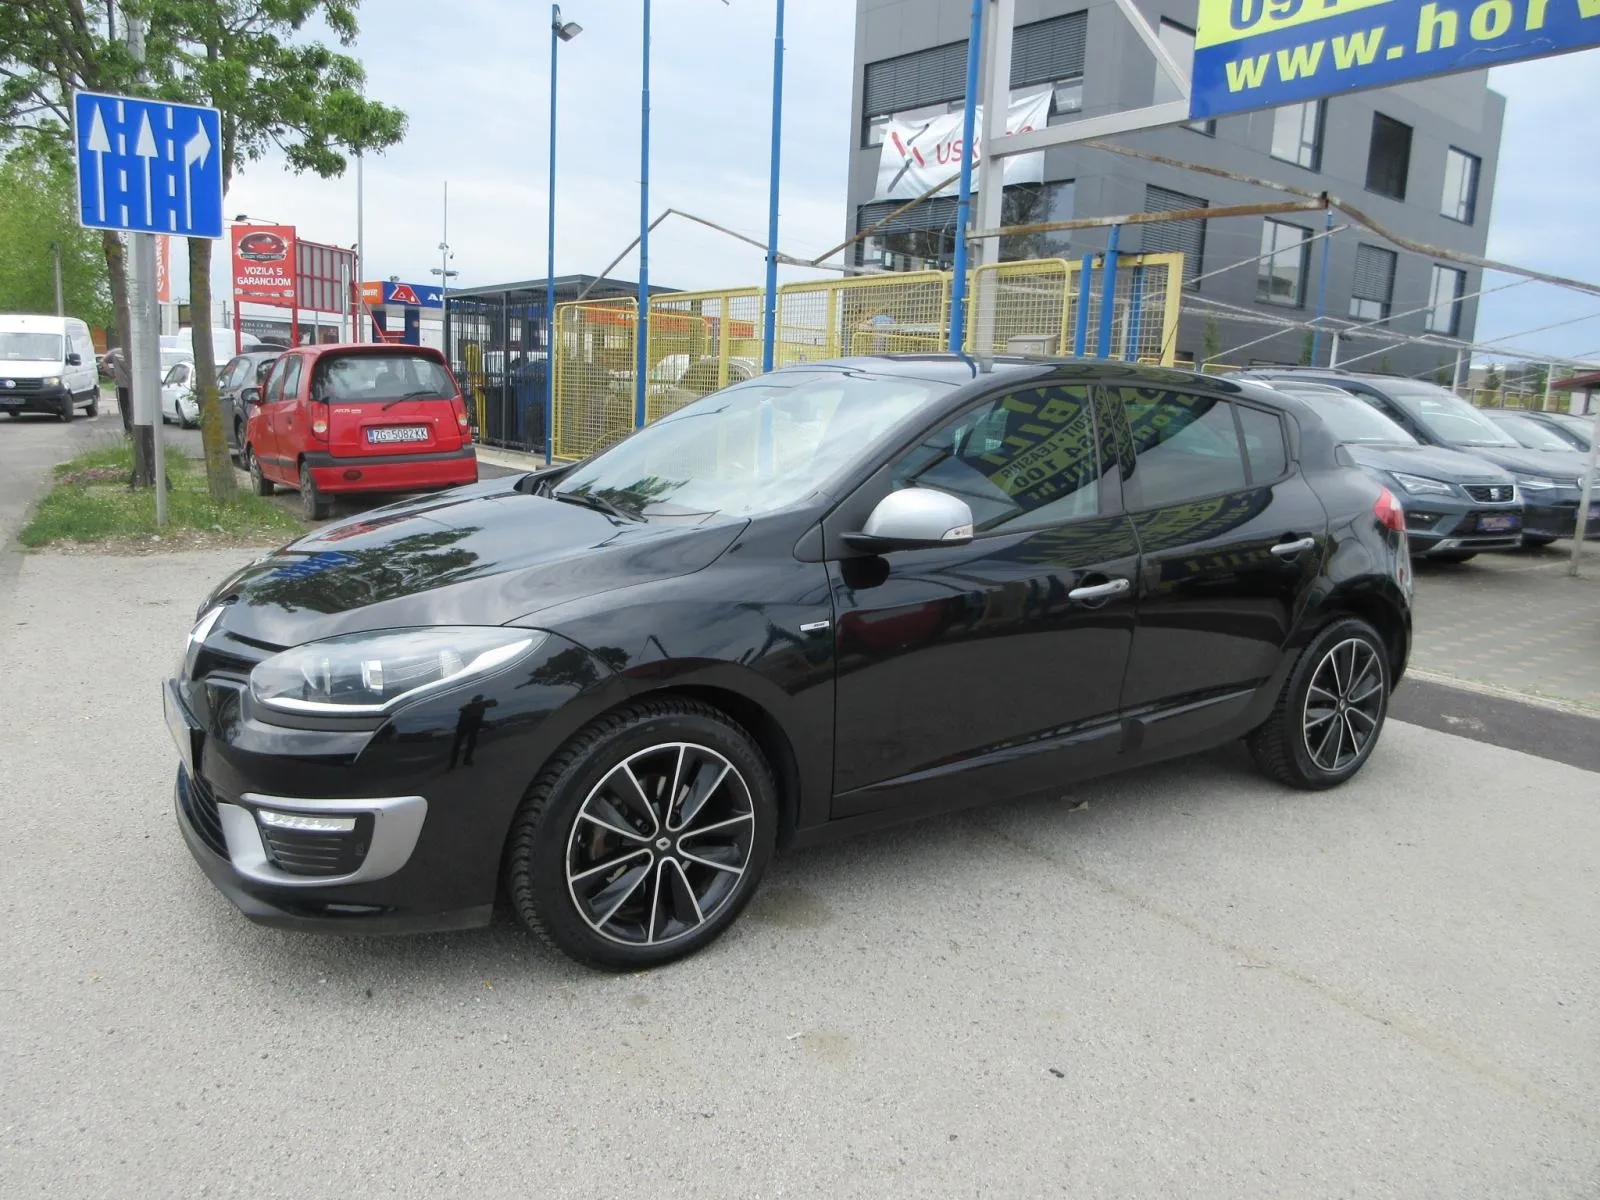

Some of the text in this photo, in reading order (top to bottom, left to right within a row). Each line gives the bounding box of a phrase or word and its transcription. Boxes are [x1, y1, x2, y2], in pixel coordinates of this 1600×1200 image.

[1229, 0, 1338, 31] 09
[244, 266, 283, 276] VOZILA S
[237, 277, 292, 287] GARANCIJOM
